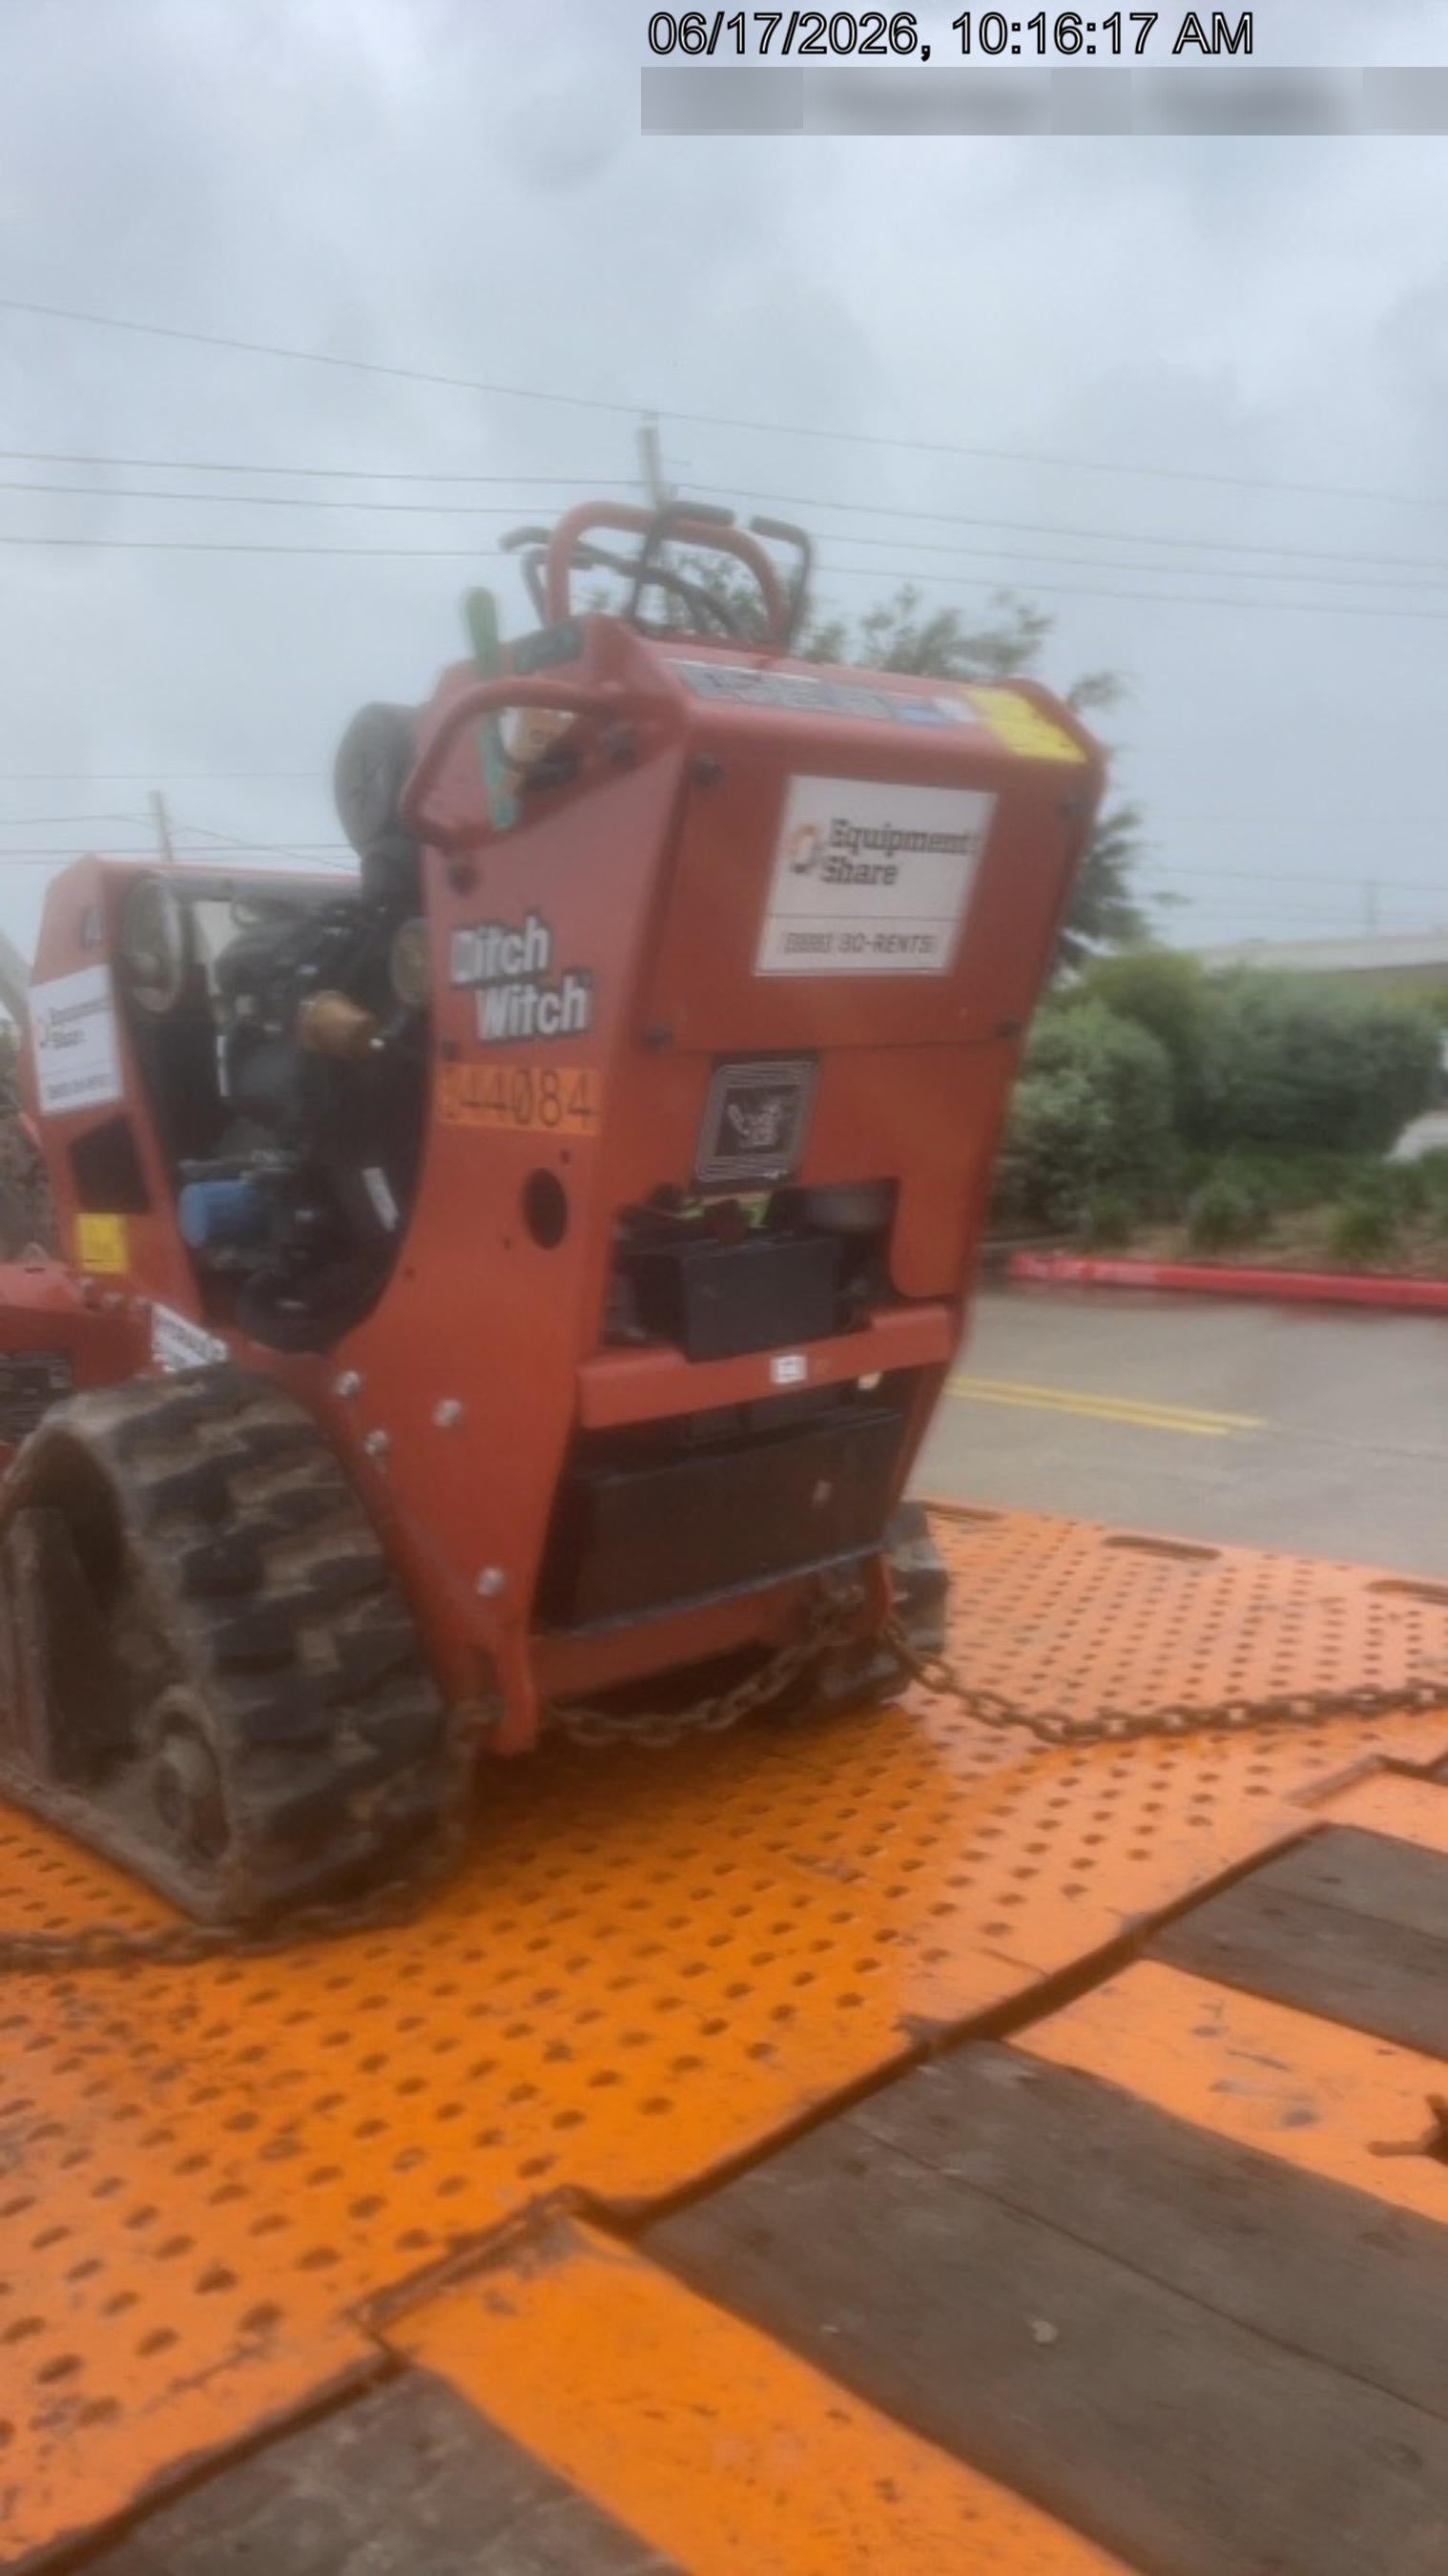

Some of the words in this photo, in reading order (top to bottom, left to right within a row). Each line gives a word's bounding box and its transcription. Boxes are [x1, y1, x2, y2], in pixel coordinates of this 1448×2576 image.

[820, 856, 900, 885] Share
[475, 973, 590, 1040] Witch
[439, 1068, 593, 1130] 44084
